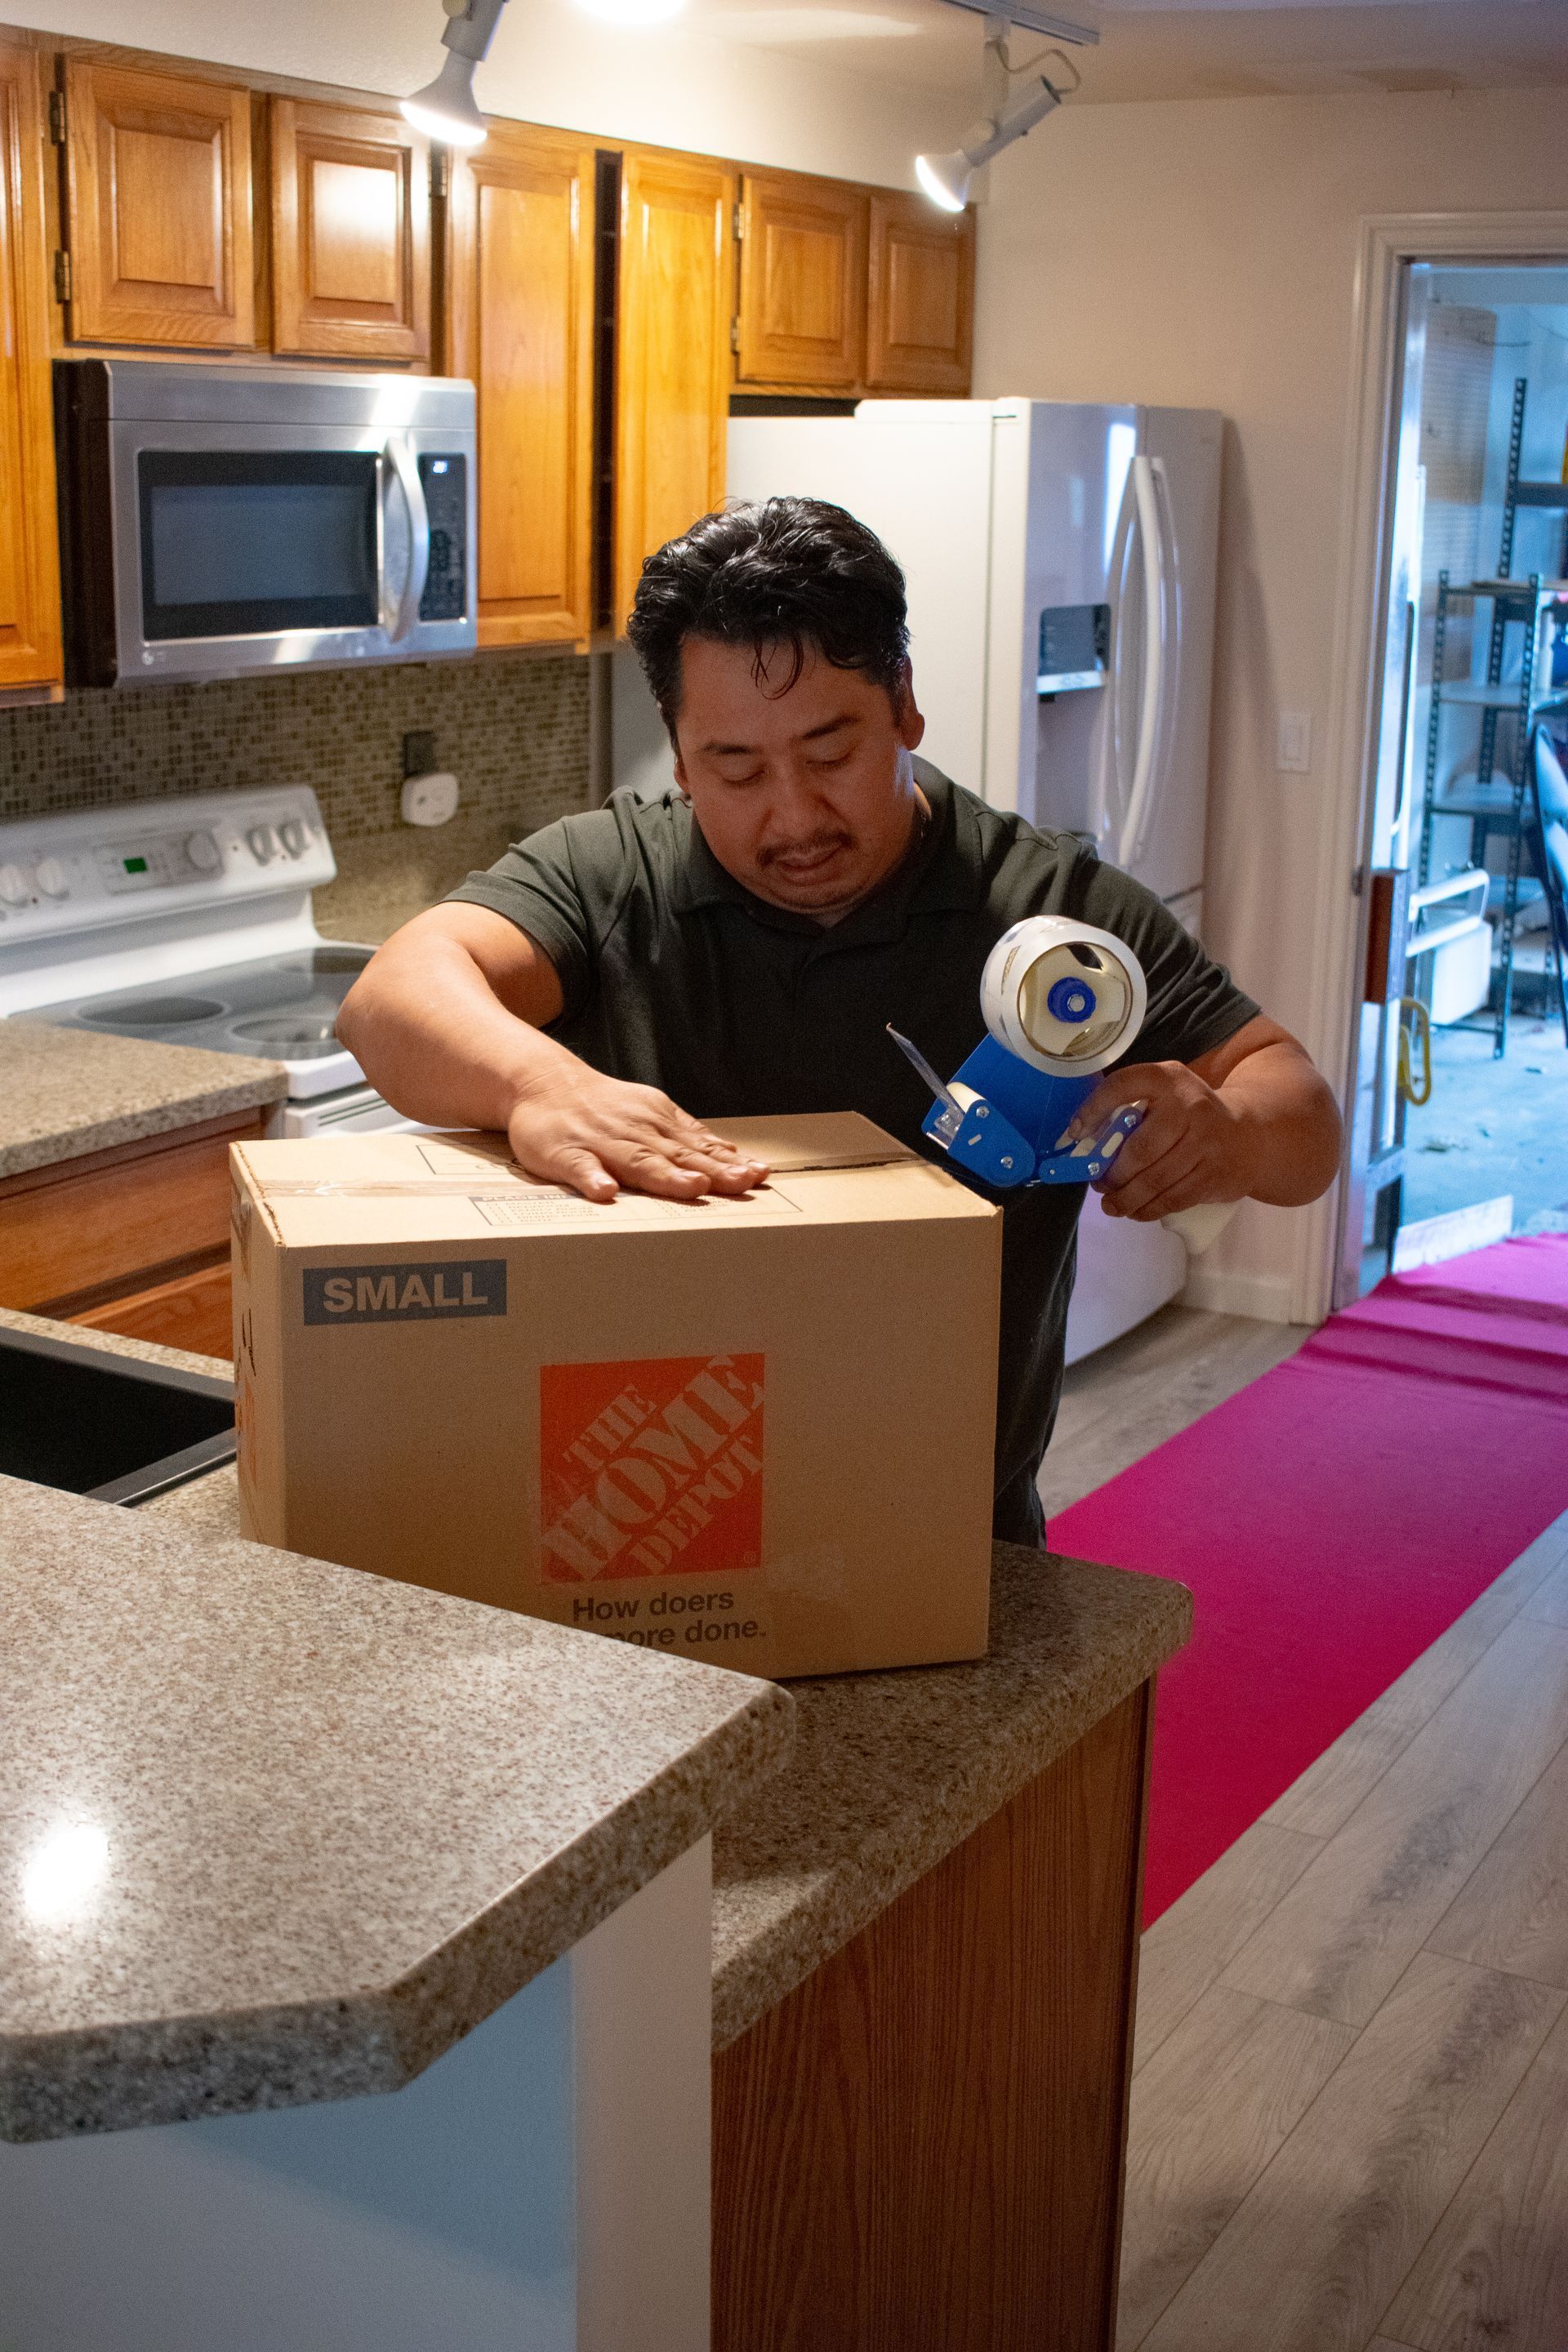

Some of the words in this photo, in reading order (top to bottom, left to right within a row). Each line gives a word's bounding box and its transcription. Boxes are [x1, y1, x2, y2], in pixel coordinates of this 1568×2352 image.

[323, 1272, 488, 1312] SMALL
[561, 1383, 657, 1471] THE
[541, 1354, 764, 1581] HOME
[628, 1434, 763, 1575] DEPOT
[572, 1597, 640, 1621] How
[648, 1592, 734, 1616] doers
[684, 1620, 767, 1643] done.
